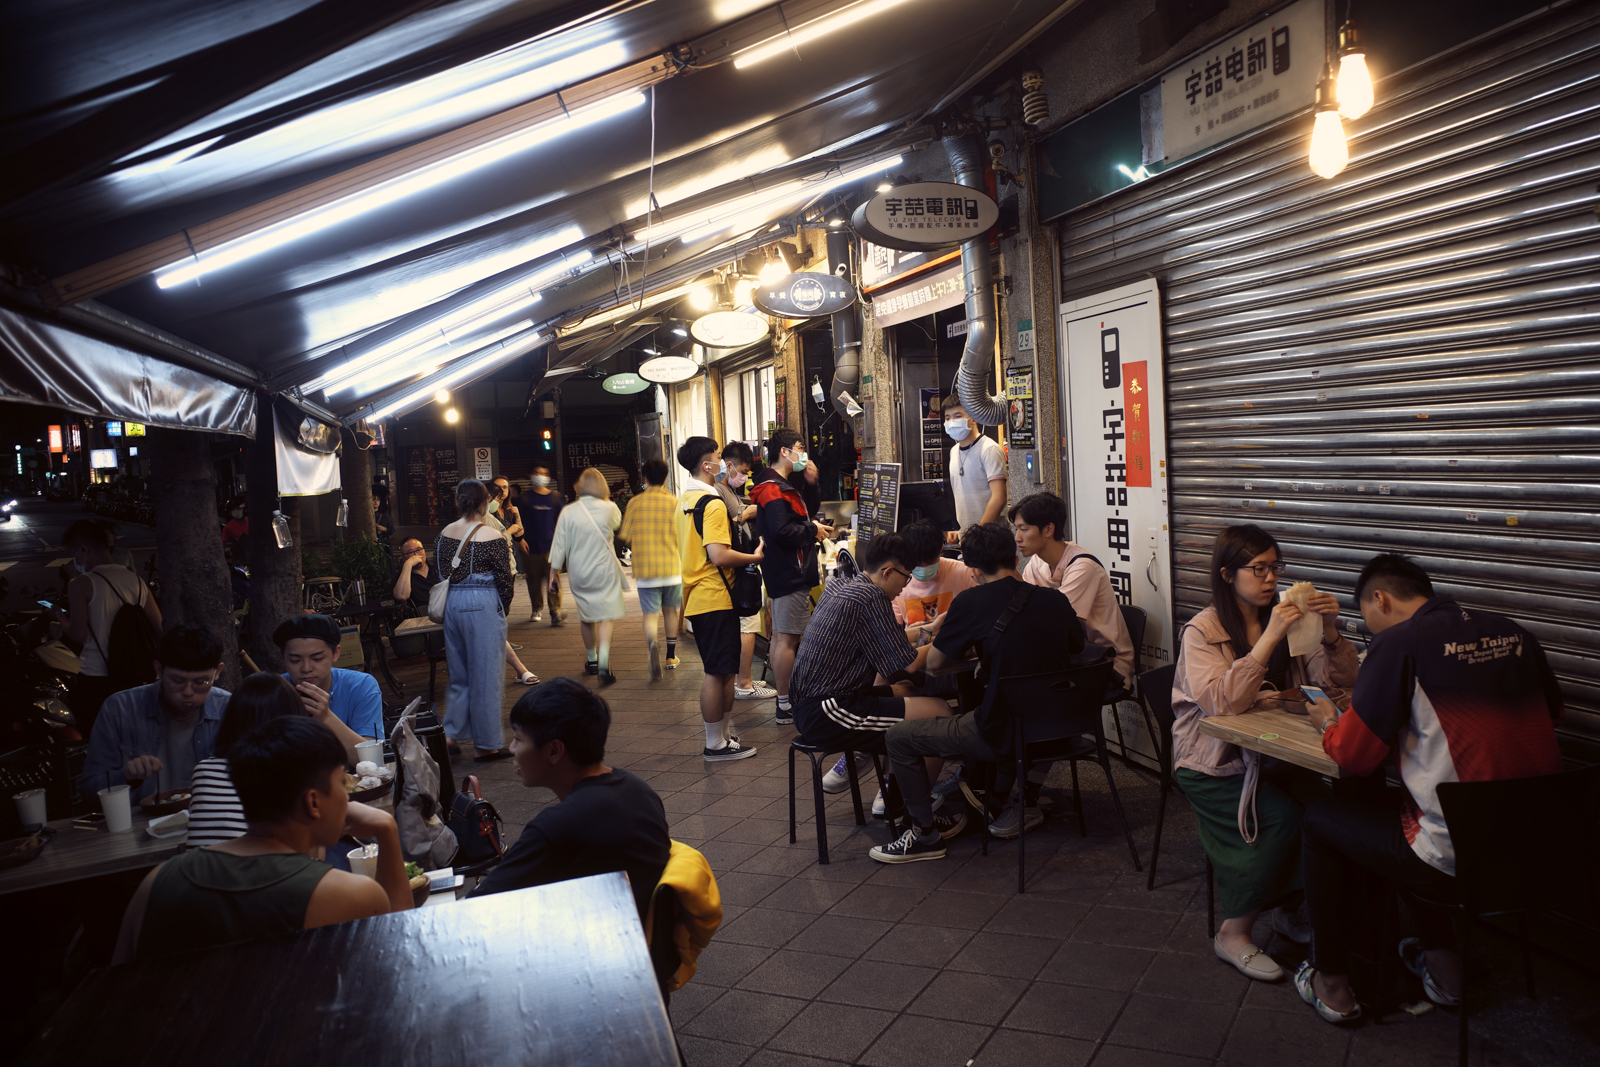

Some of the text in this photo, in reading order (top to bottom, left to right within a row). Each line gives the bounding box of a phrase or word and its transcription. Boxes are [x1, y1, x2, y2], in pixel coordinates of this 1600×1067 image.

[885, 198, 963, 216] 宇喆電訊
[1019, 333, 1030, 348] 29
[568, 441, 622, 456] AFTERNOO
[1444, 634, 1519, 656] New Taipei
[1458, 644, 1513, 661] Fire Department
[1468, 650, 1510, 664] Dragon Boat
